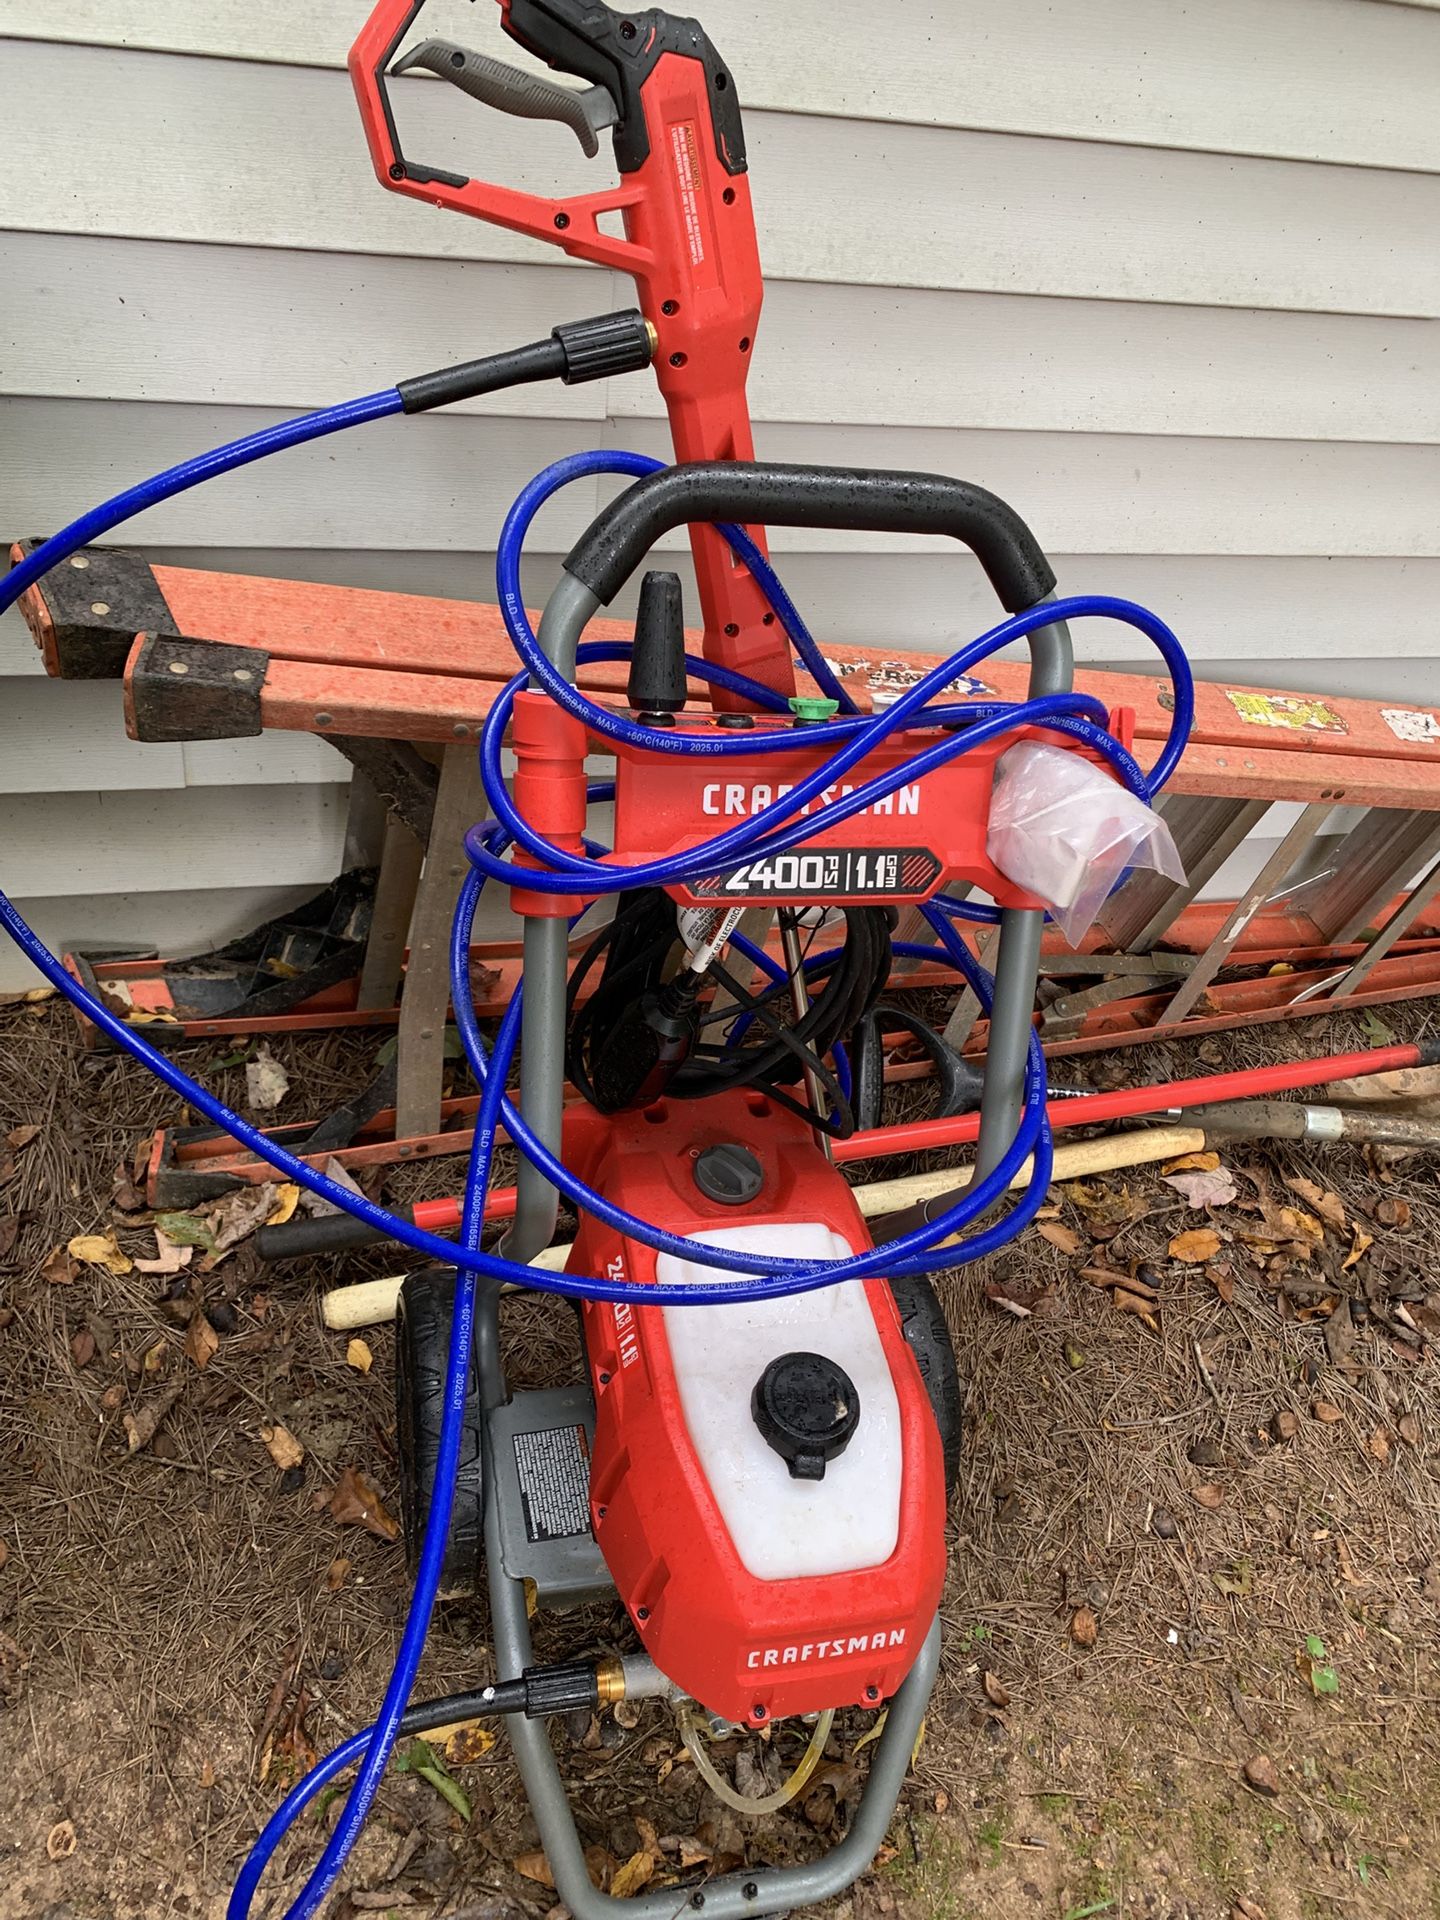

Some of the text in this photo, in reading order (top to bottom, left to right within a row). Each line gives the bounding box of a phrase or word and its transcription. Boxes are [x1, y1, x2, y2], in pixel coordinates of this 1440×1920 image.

[505, 593, 518, 615] BLD
[689, 743, 724, 753] 2025.01
[975, 708, 994, 719] BLD
[702, 784, 920, 815] CRASAN
[725, 856, 824, 890] 2400
[823, 856, 840, 889] PSI
[855, 856, 886, 888] 1.1
[31, 938, 55, 965] 2025.01
[480, 1129, 491, 1148] BLD
[219, 1108, 236, 1121] BLD
[364, 1203, 393, 1221] 2025.01
[475, 1155, 487, 1177] MAX
[653, 1283, 676, 1291] MAX
[619, 1333, 638, 1361] 1.1
[453, 1373, 465, 1410] 2025.01
[747, 1628, 905, 1668] CRAFTSMAN
